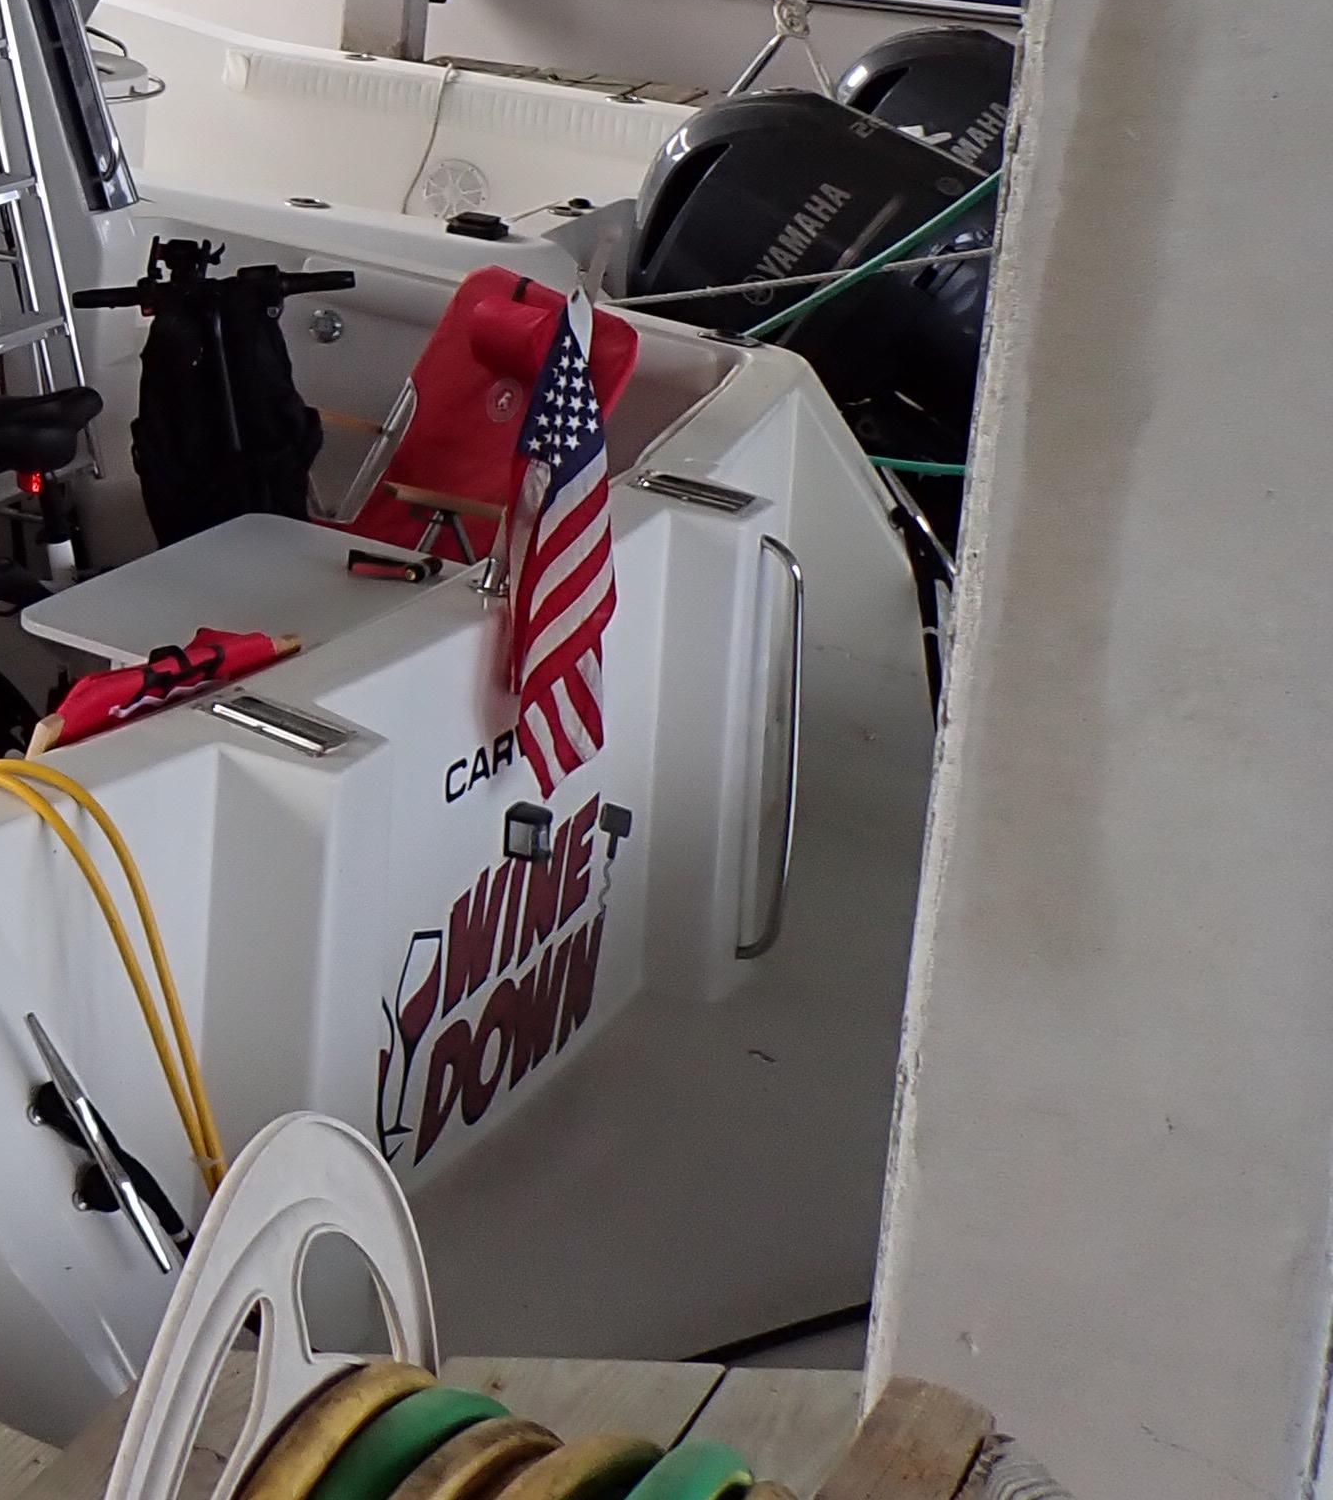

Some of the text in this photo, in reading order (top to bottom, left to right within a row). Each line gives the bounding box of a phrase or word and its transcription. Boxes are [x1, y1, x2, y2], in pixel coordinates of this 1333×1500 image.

[756, 183, 852, 279] YAMAHA
[442, 792, 601, 1019] WINE
[414, 911, 606, 1167] DOWN
